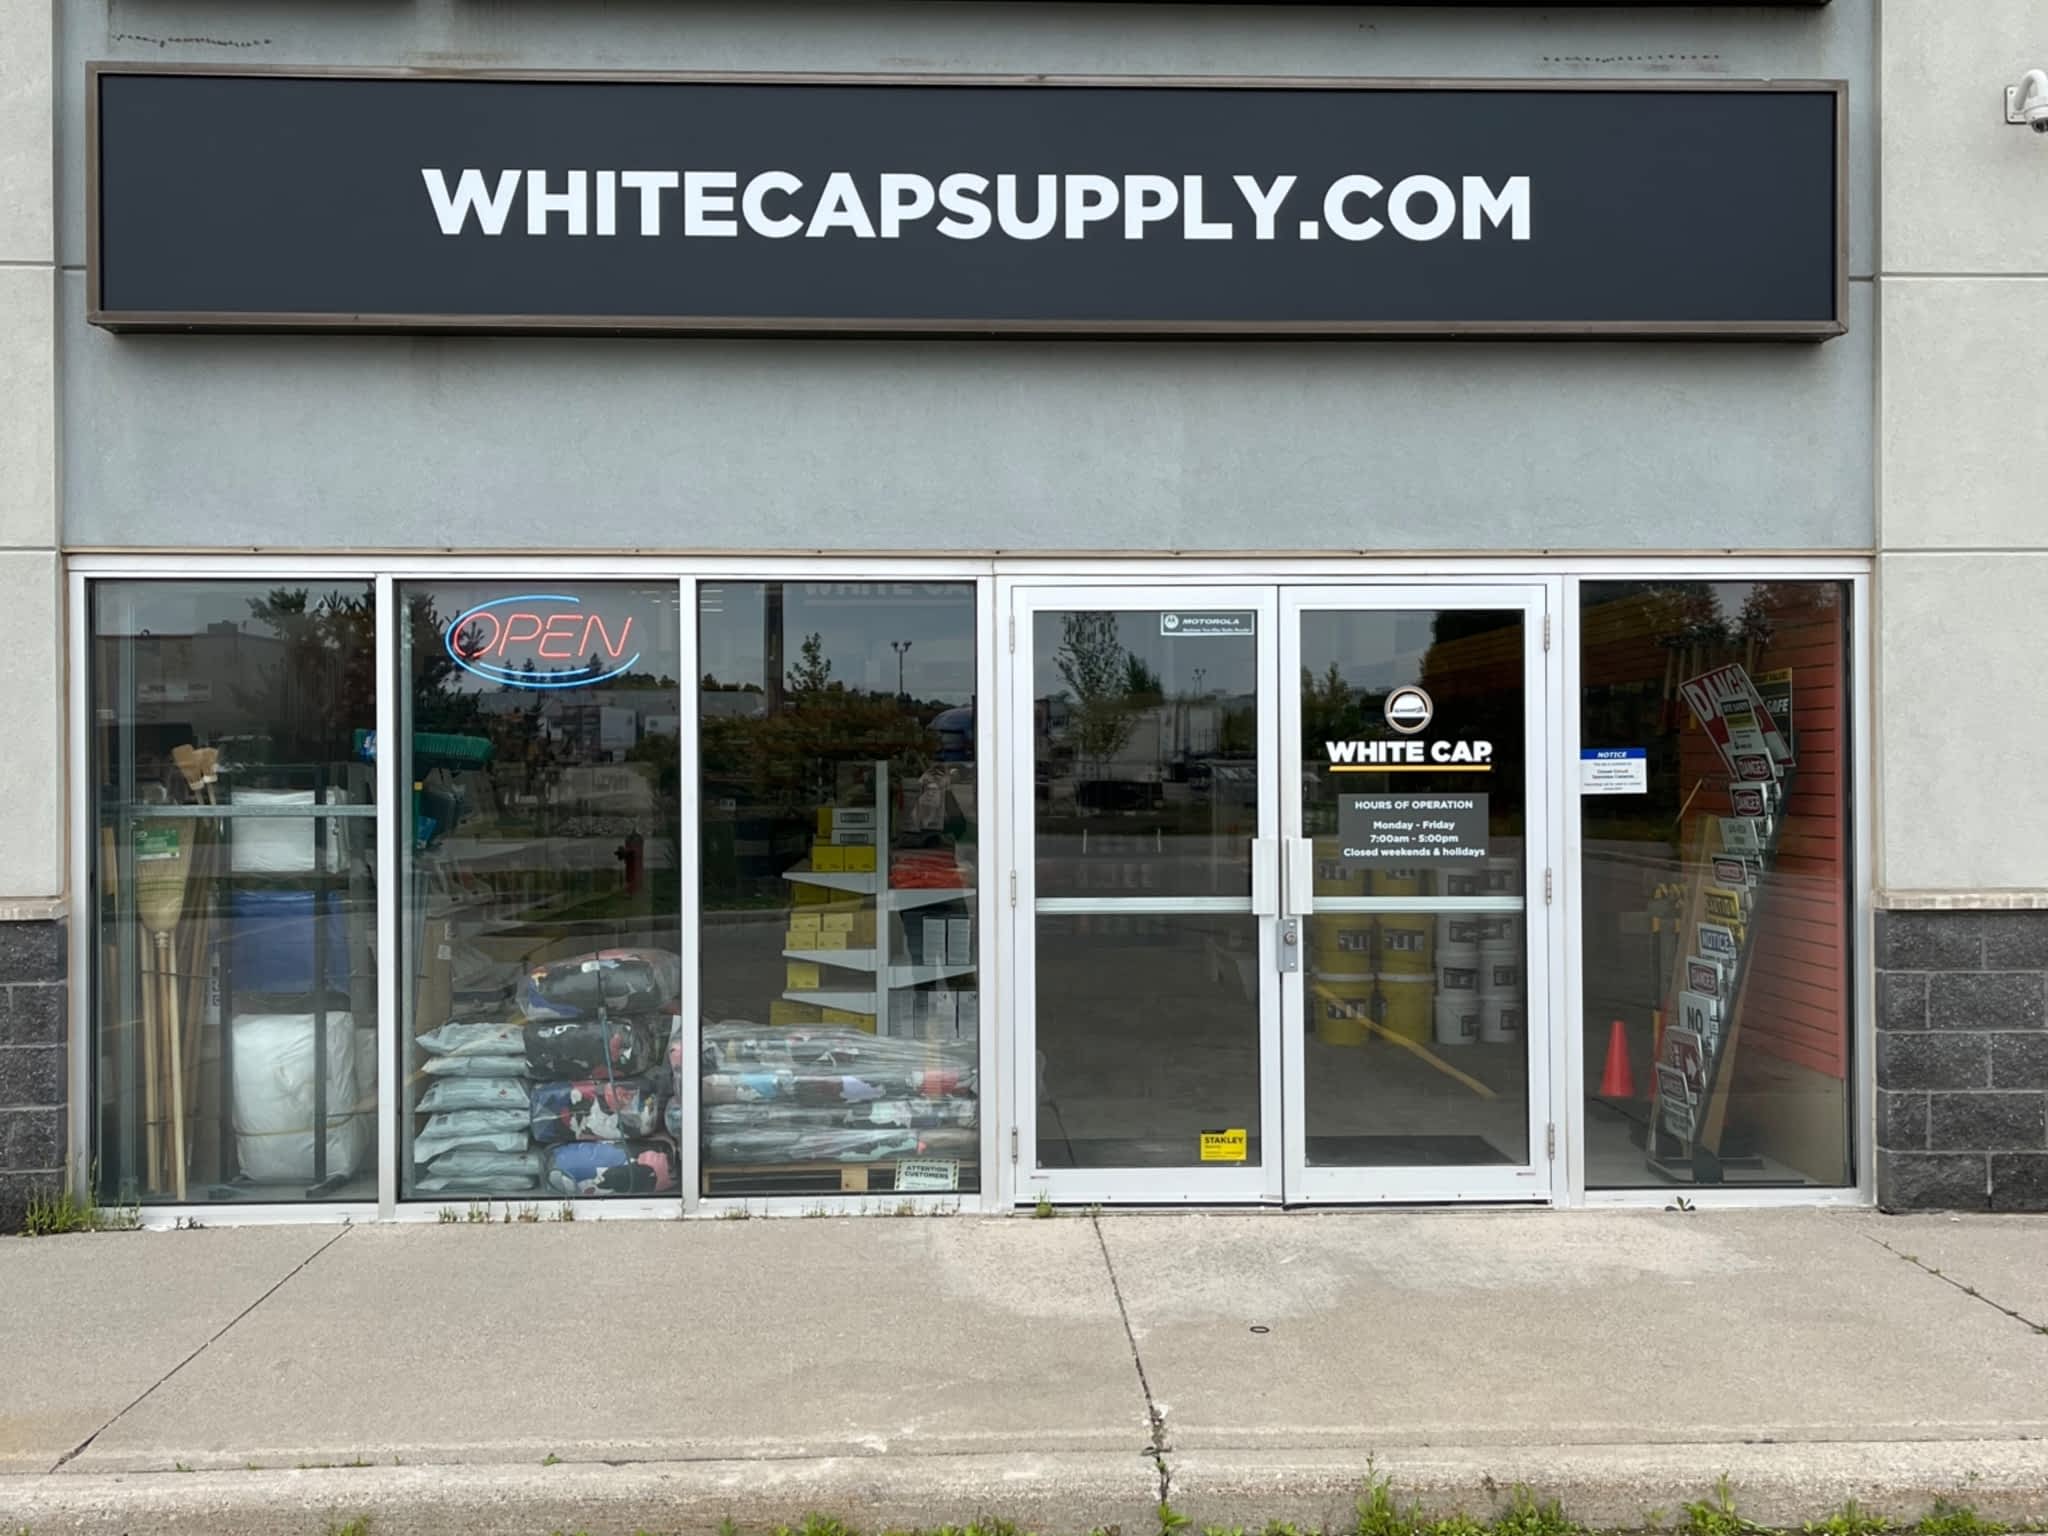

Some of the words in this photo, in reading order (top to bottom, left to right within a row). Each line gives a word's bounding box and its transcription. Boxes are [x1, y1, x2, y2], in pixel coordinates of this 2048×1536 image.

[422, 169, 1530, 240] WHITECAPSUPPLY.COM
[453, 612, 633, 658] OPEN
[1326, 741, 1424, 762] WHITE
[1355, 801, 1392, 809] HOURS
[1395, 801, 1409, 809] OF
[1412, 801, 1473, 809] OPERATION
[1373, 821, 1413, 830] Monday
[1423, 821, 1455, 830] Friday
[1419, 834, 1458, 843] 5:00pm
[1344, 848, 1378, 856] Closed
[1381, 848, 1430, 856] weekends
[1433, 848, 1440, 856] &
[1443, 848, 1485, 857] holidays
[1687, 1005, 1703, 1034] NO
[905, 1171, 948, 1179] CUSTOMERS
